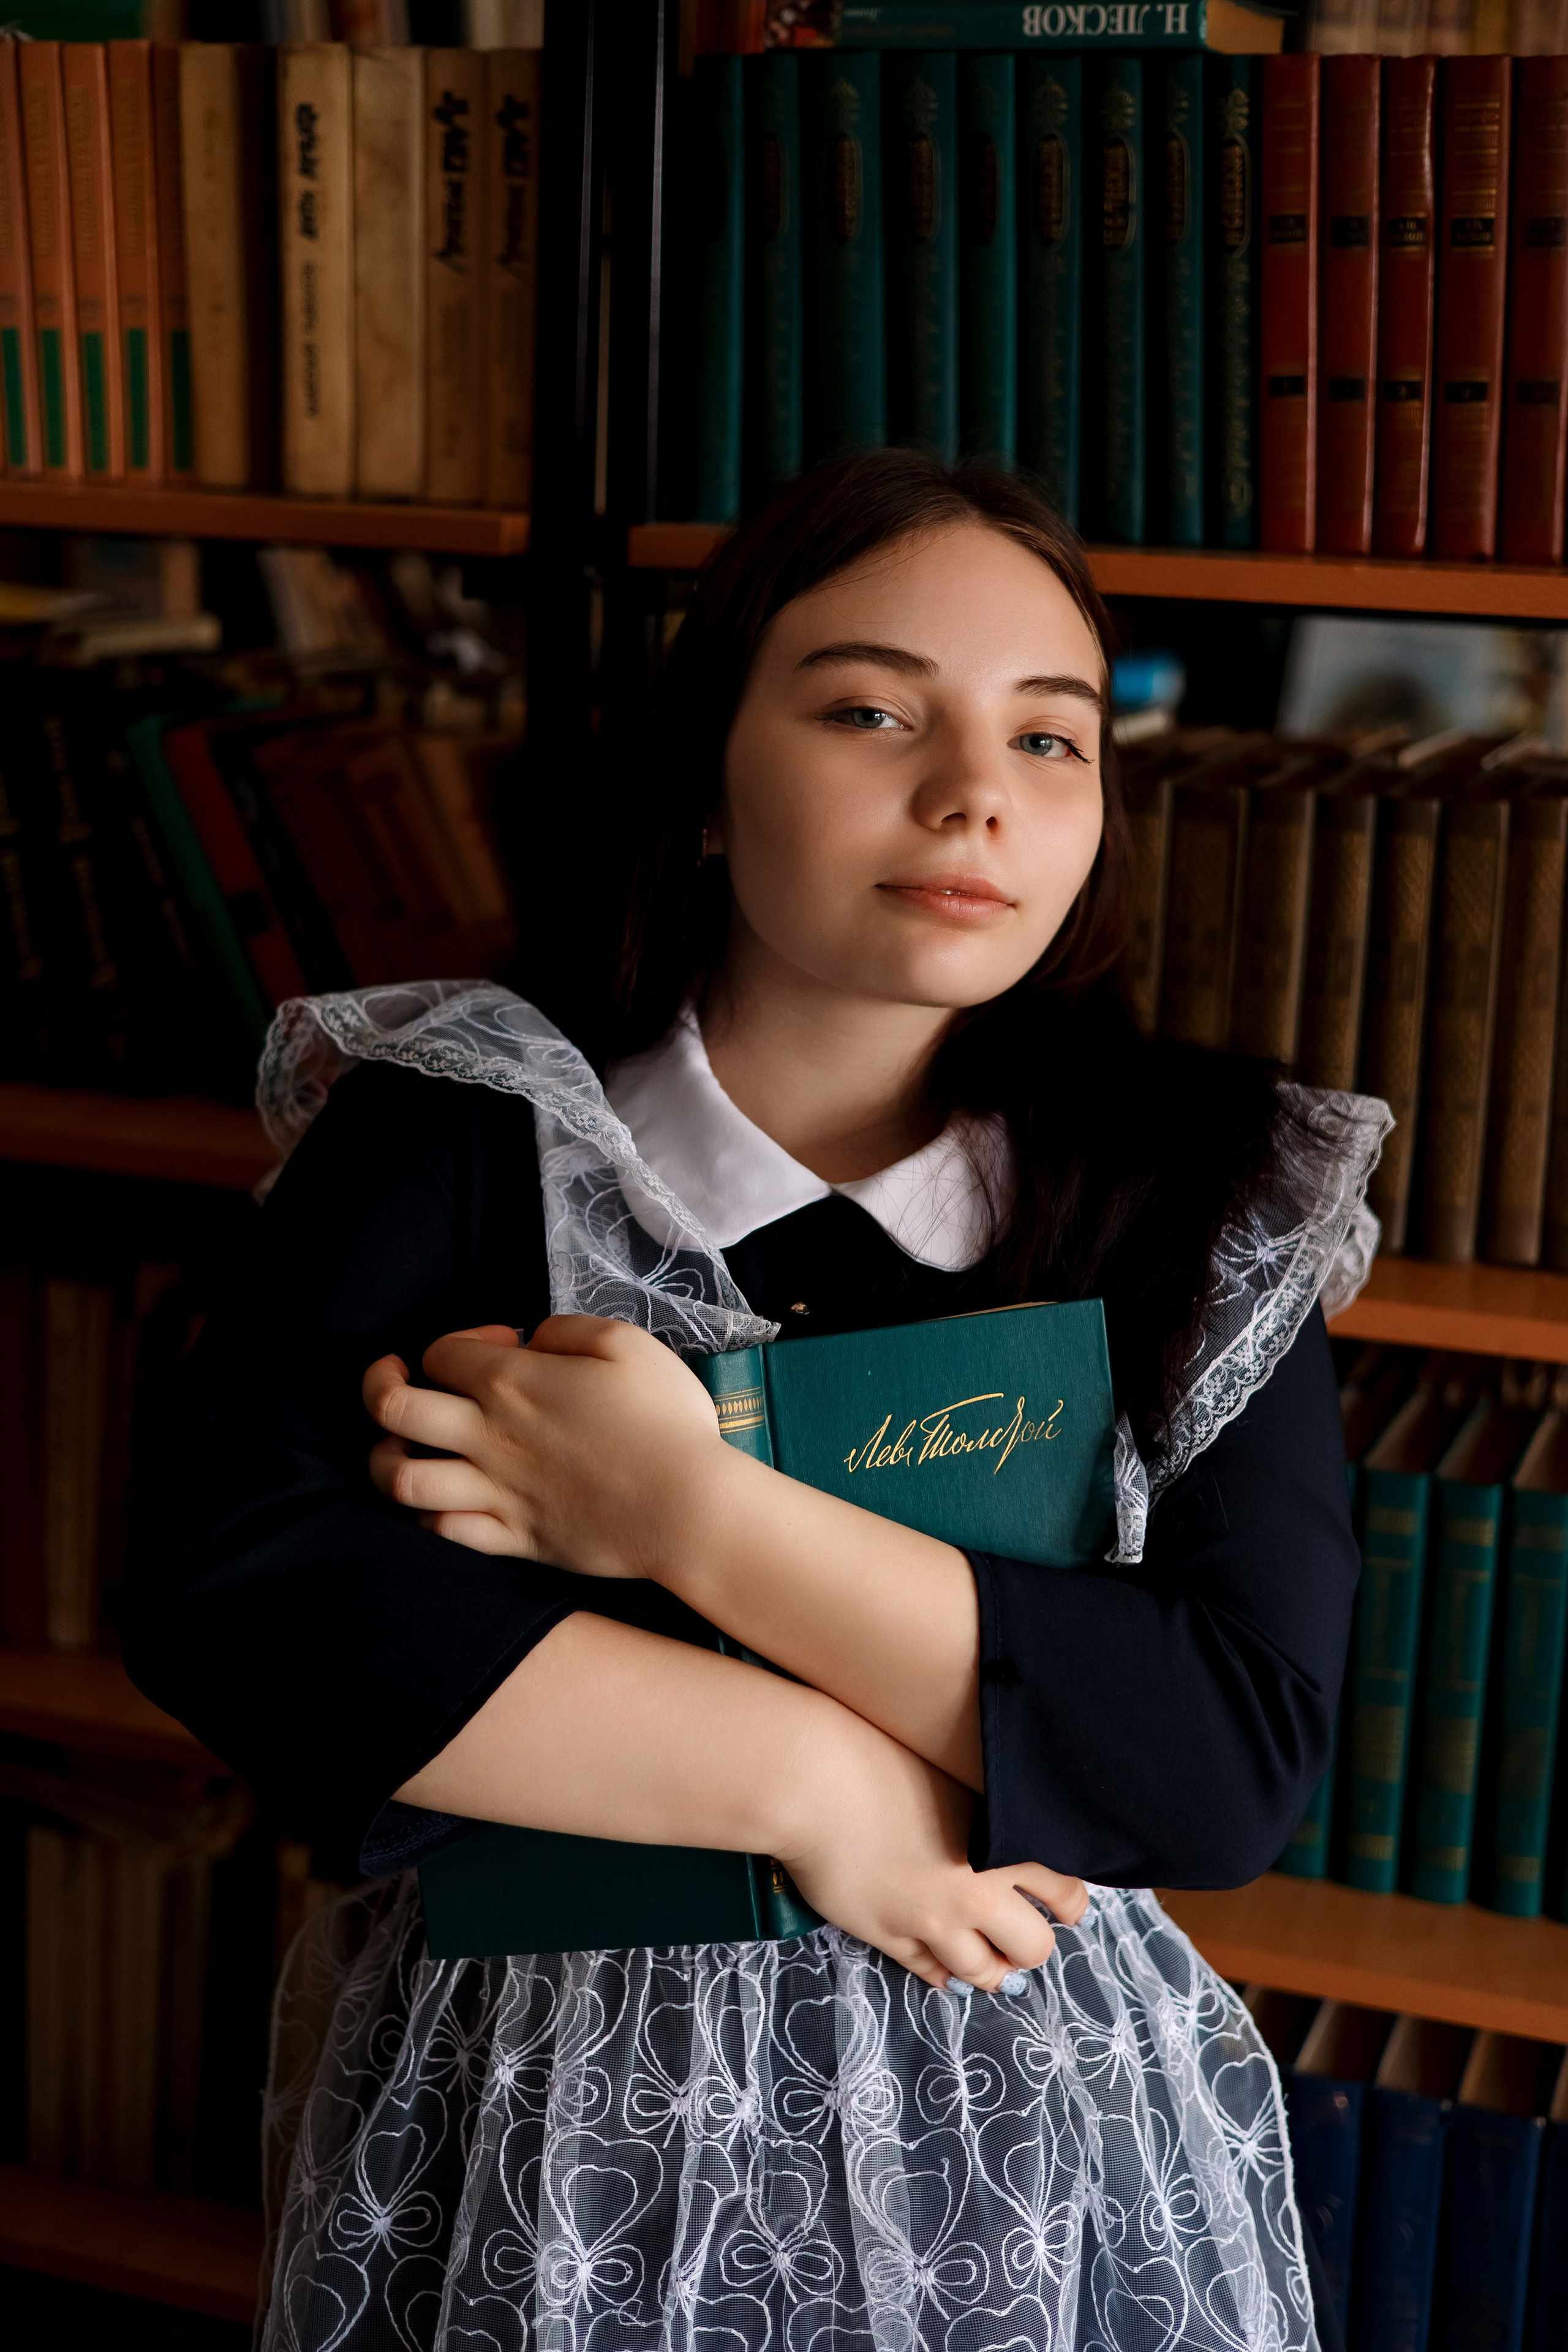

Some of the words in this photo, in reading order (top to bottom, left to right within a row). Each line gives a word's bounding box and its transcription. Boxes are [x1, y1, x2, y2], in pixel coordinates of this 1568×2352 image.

[1022, 4, 1152, 37] ЛЕСКОВ
[1156, 3, 1189, 35] Н.
[918, 1392, 1064, 1475] Толстой
